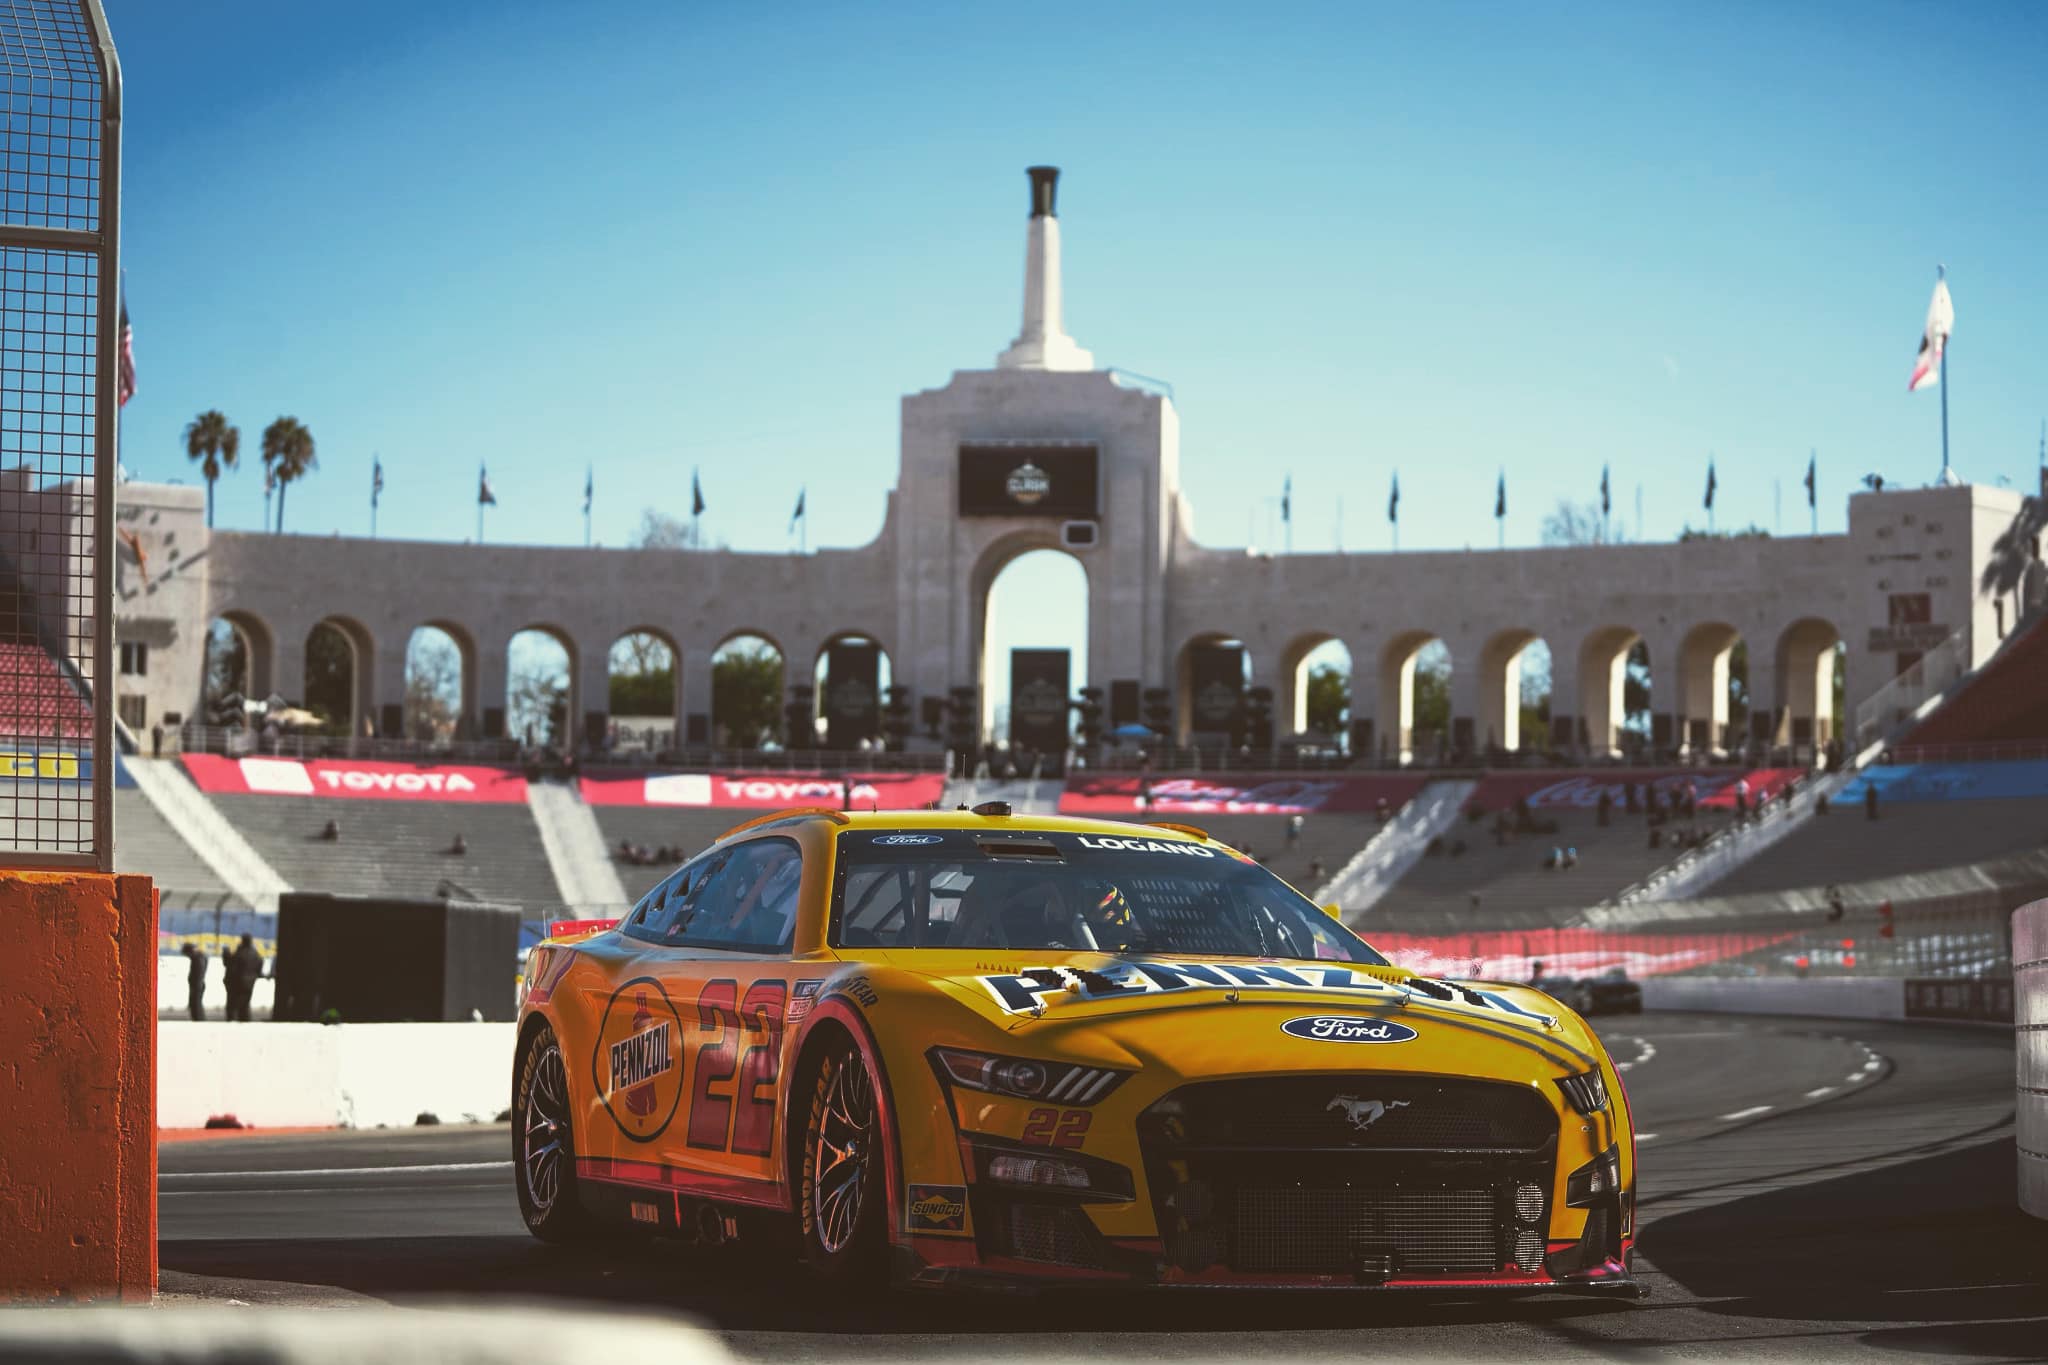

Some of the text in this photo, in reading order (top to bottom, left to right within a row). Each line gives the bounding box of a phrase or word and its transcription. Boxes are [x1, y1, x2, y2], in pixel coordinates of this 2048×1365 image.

[319, 769, 476, 792] TOYOTA
[722, 781, 879, 799] TOYOTA
[1077, 836, 1215, 858] LOGANO
[1311, 1018, 1392, 1039] Ford
[611, 1021, 672, 1093] PENNZOIL
[686, 978, 788, 1159] 22
[1021, 1107, 1093, 1150] 22
[912, 1202, 962, 1216] SUNOCO
